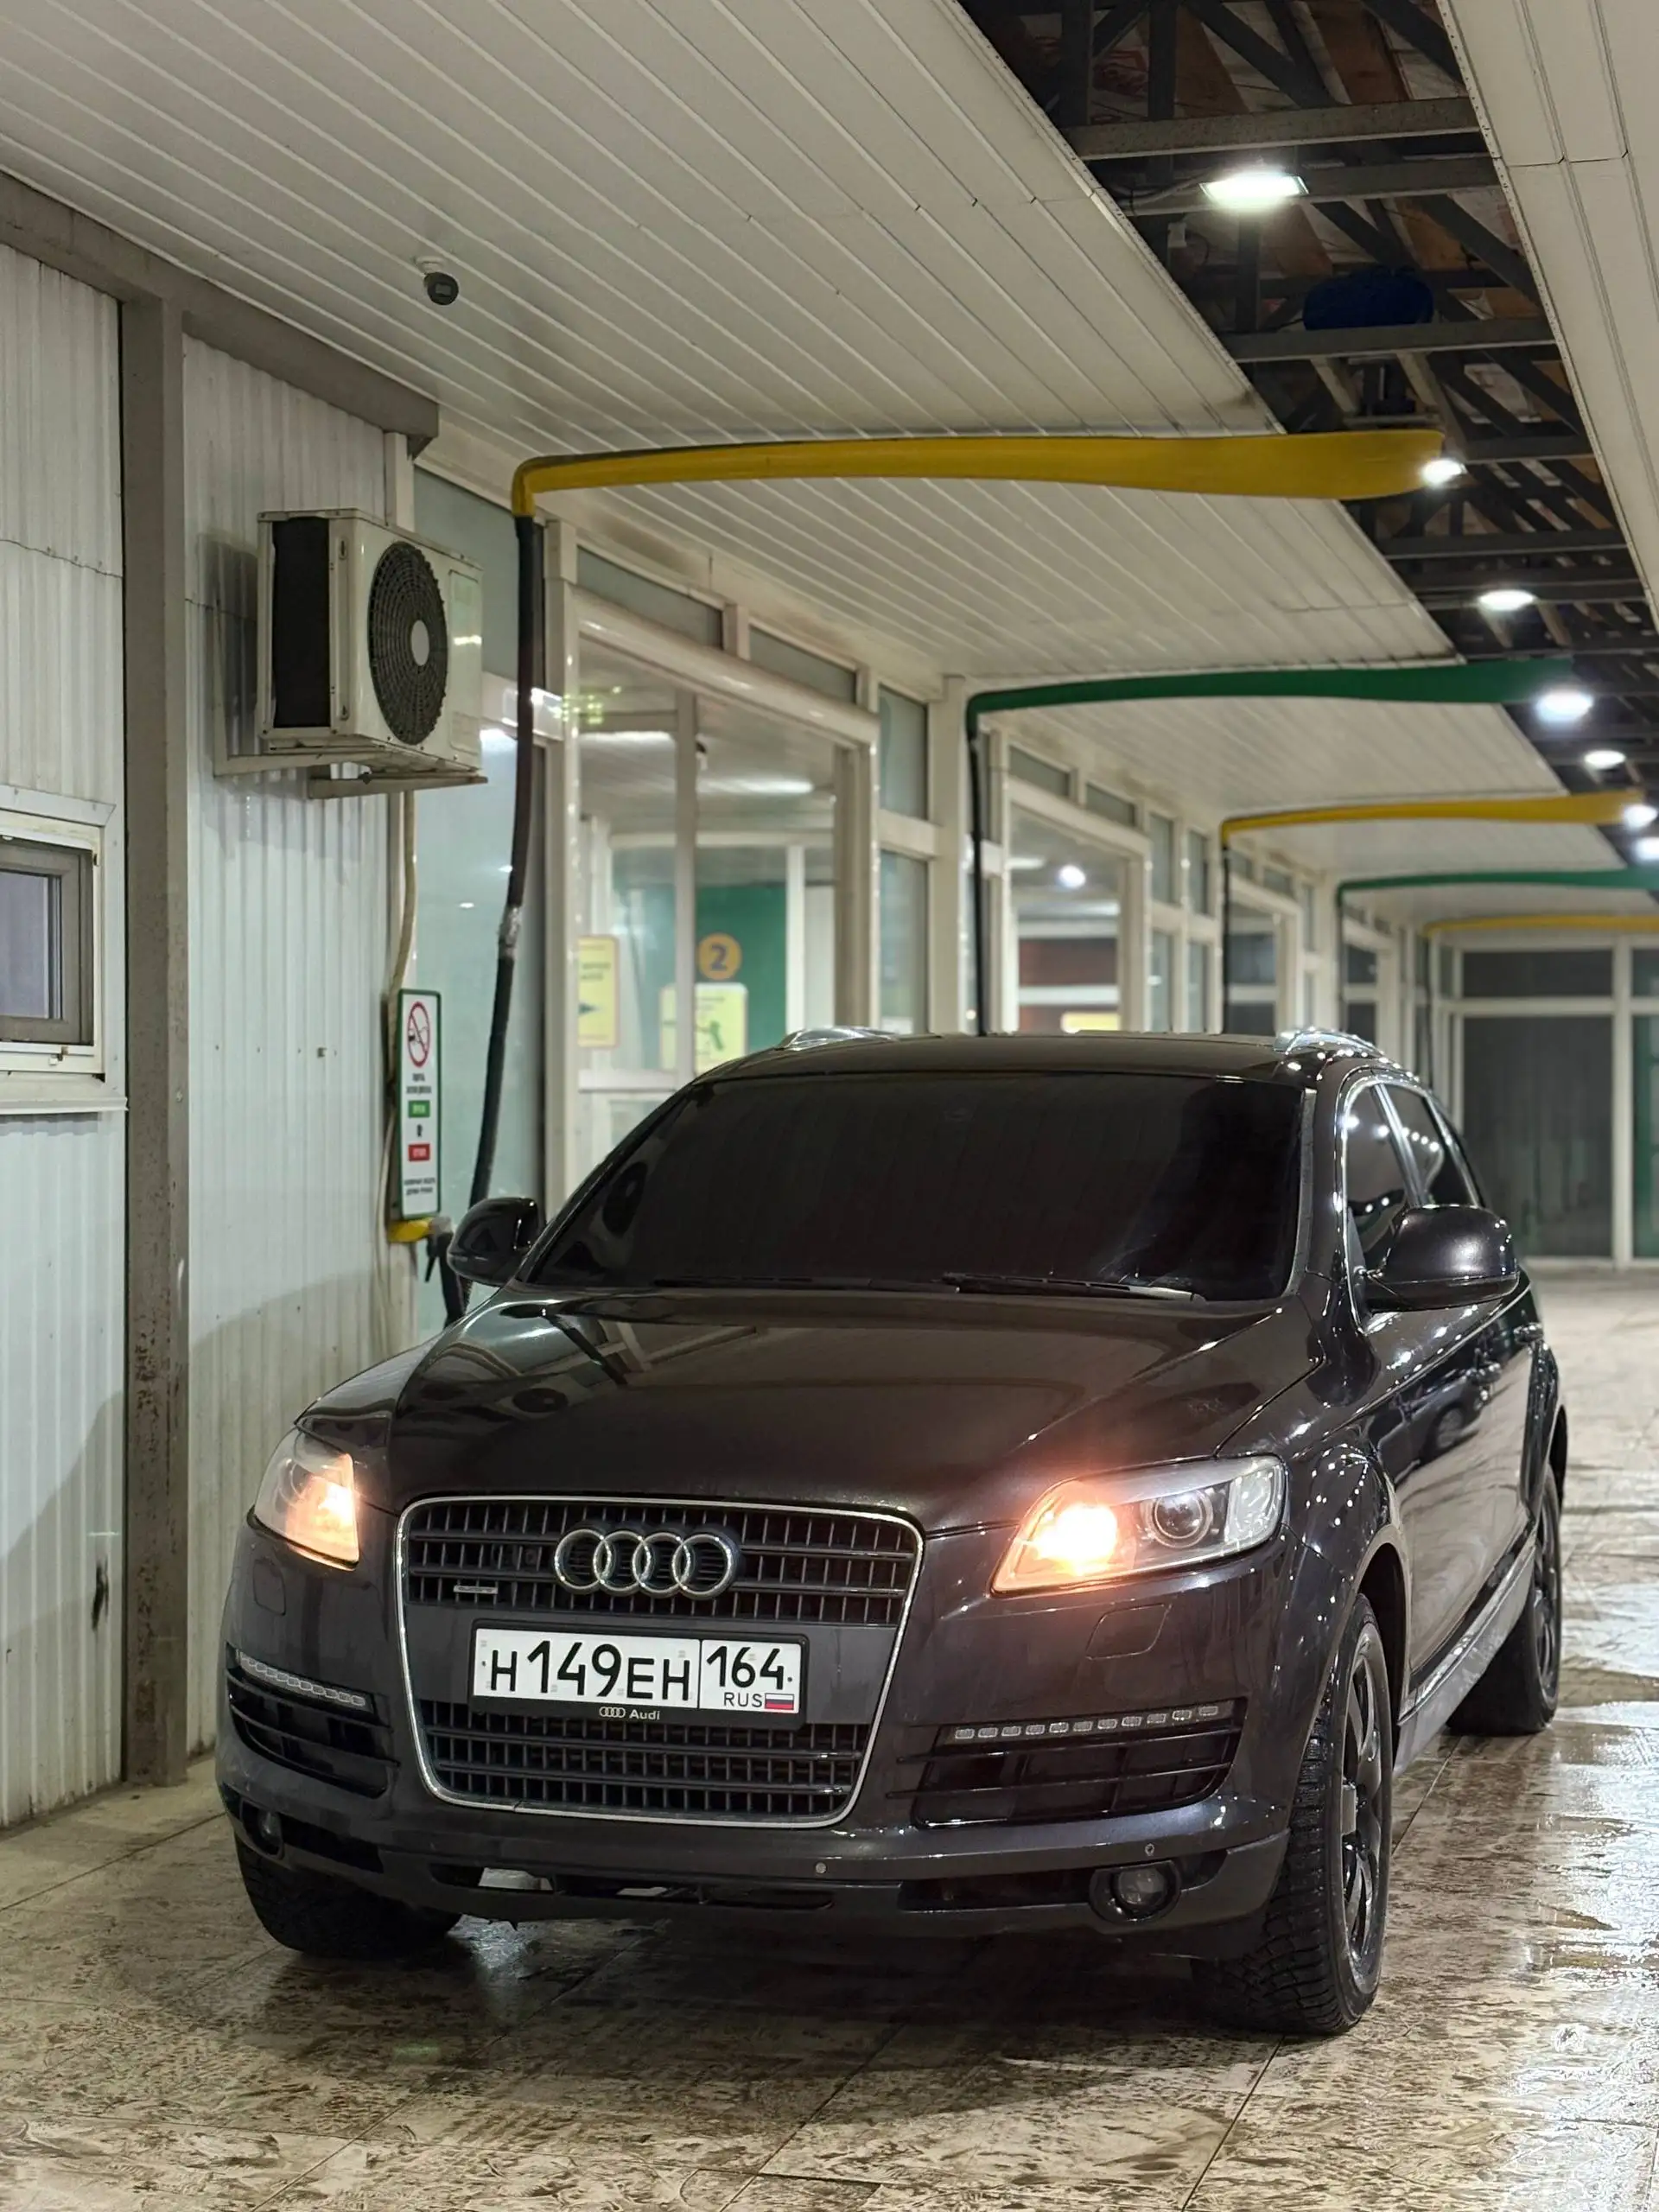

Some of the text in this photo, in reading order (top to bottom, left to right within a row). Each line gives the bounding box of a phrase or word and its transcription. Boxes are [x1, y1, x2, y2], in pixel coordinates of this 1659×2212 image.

[709, 944, 728, 971] 2
[706, 1645, 784, 1690] 164
[723, 1692, 762, 1707] RUS
[629, 1709, 660, 1720] Audi
